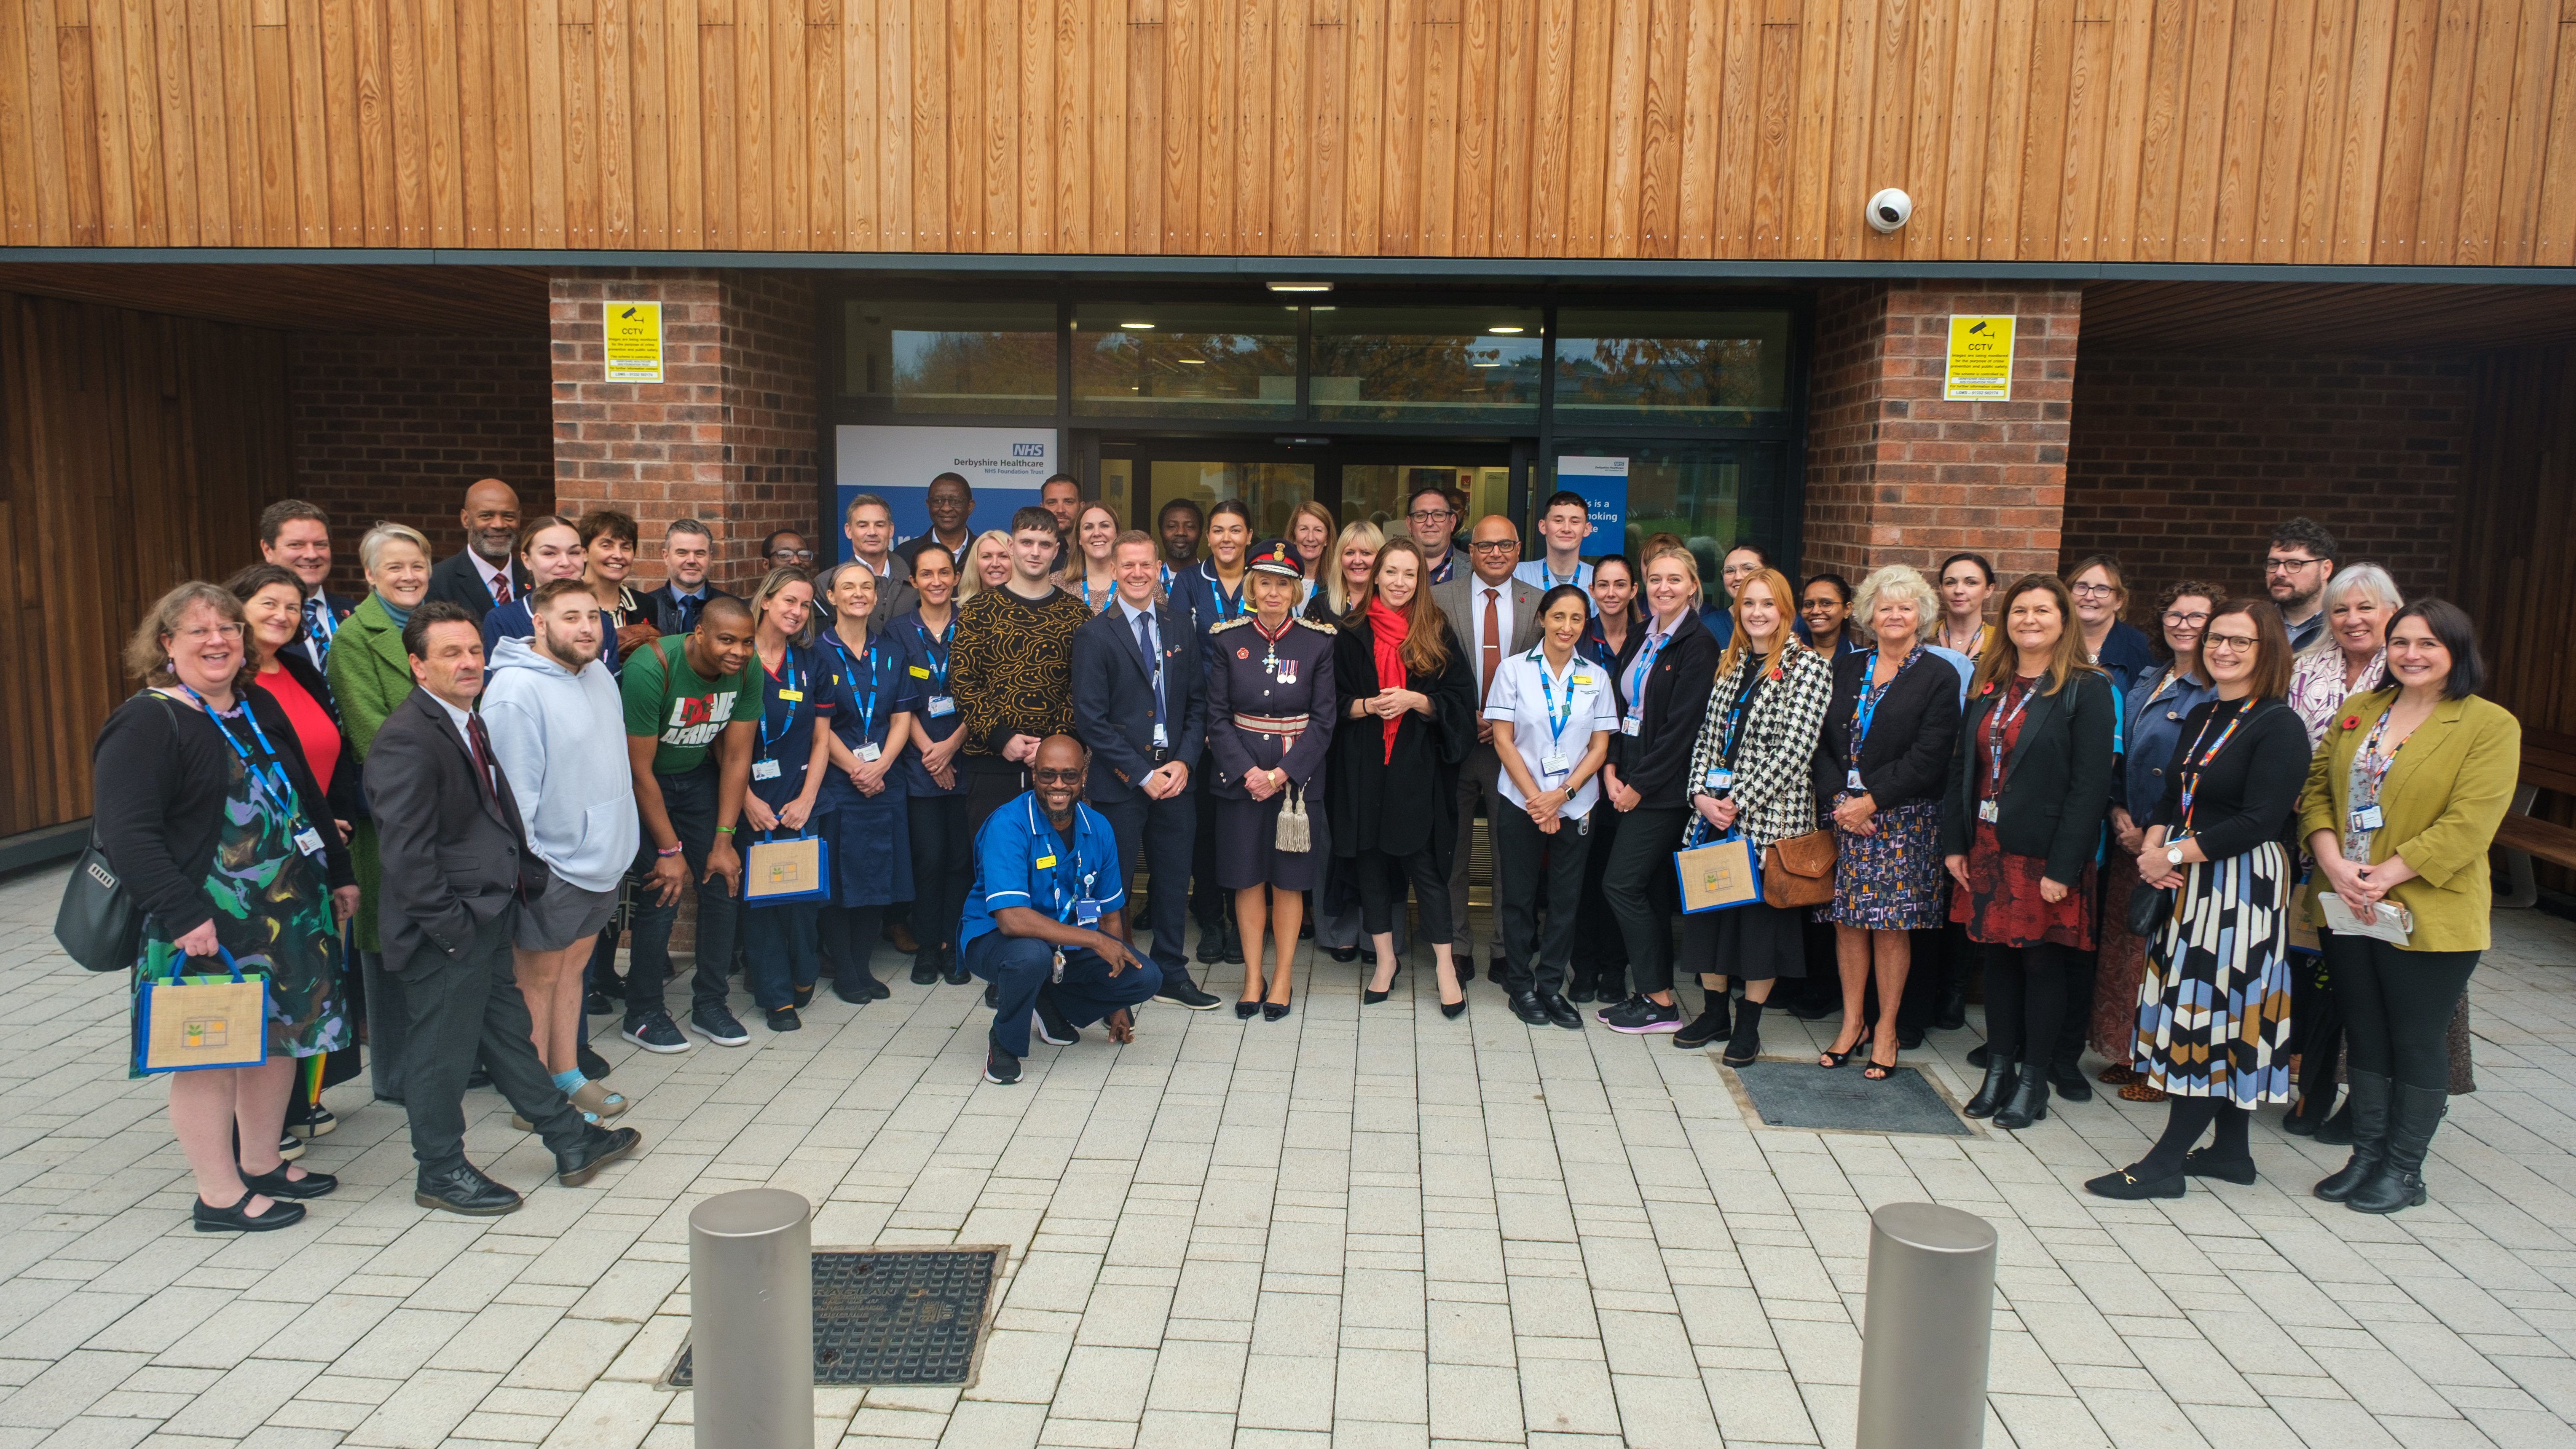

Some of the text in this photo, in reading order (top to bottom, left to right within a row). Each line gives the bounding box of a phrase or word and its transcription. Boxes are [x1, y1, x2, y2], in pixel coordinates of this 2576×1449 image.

[1014, 445, 1043, 456] NHS
[954, 458, 1043, 467] Derbyshire Healthcare
[1594, 499, 1601, 507] is
[2214, 737, 2225, 749] NHS
[2381, 759, 2394, 771] NHS
